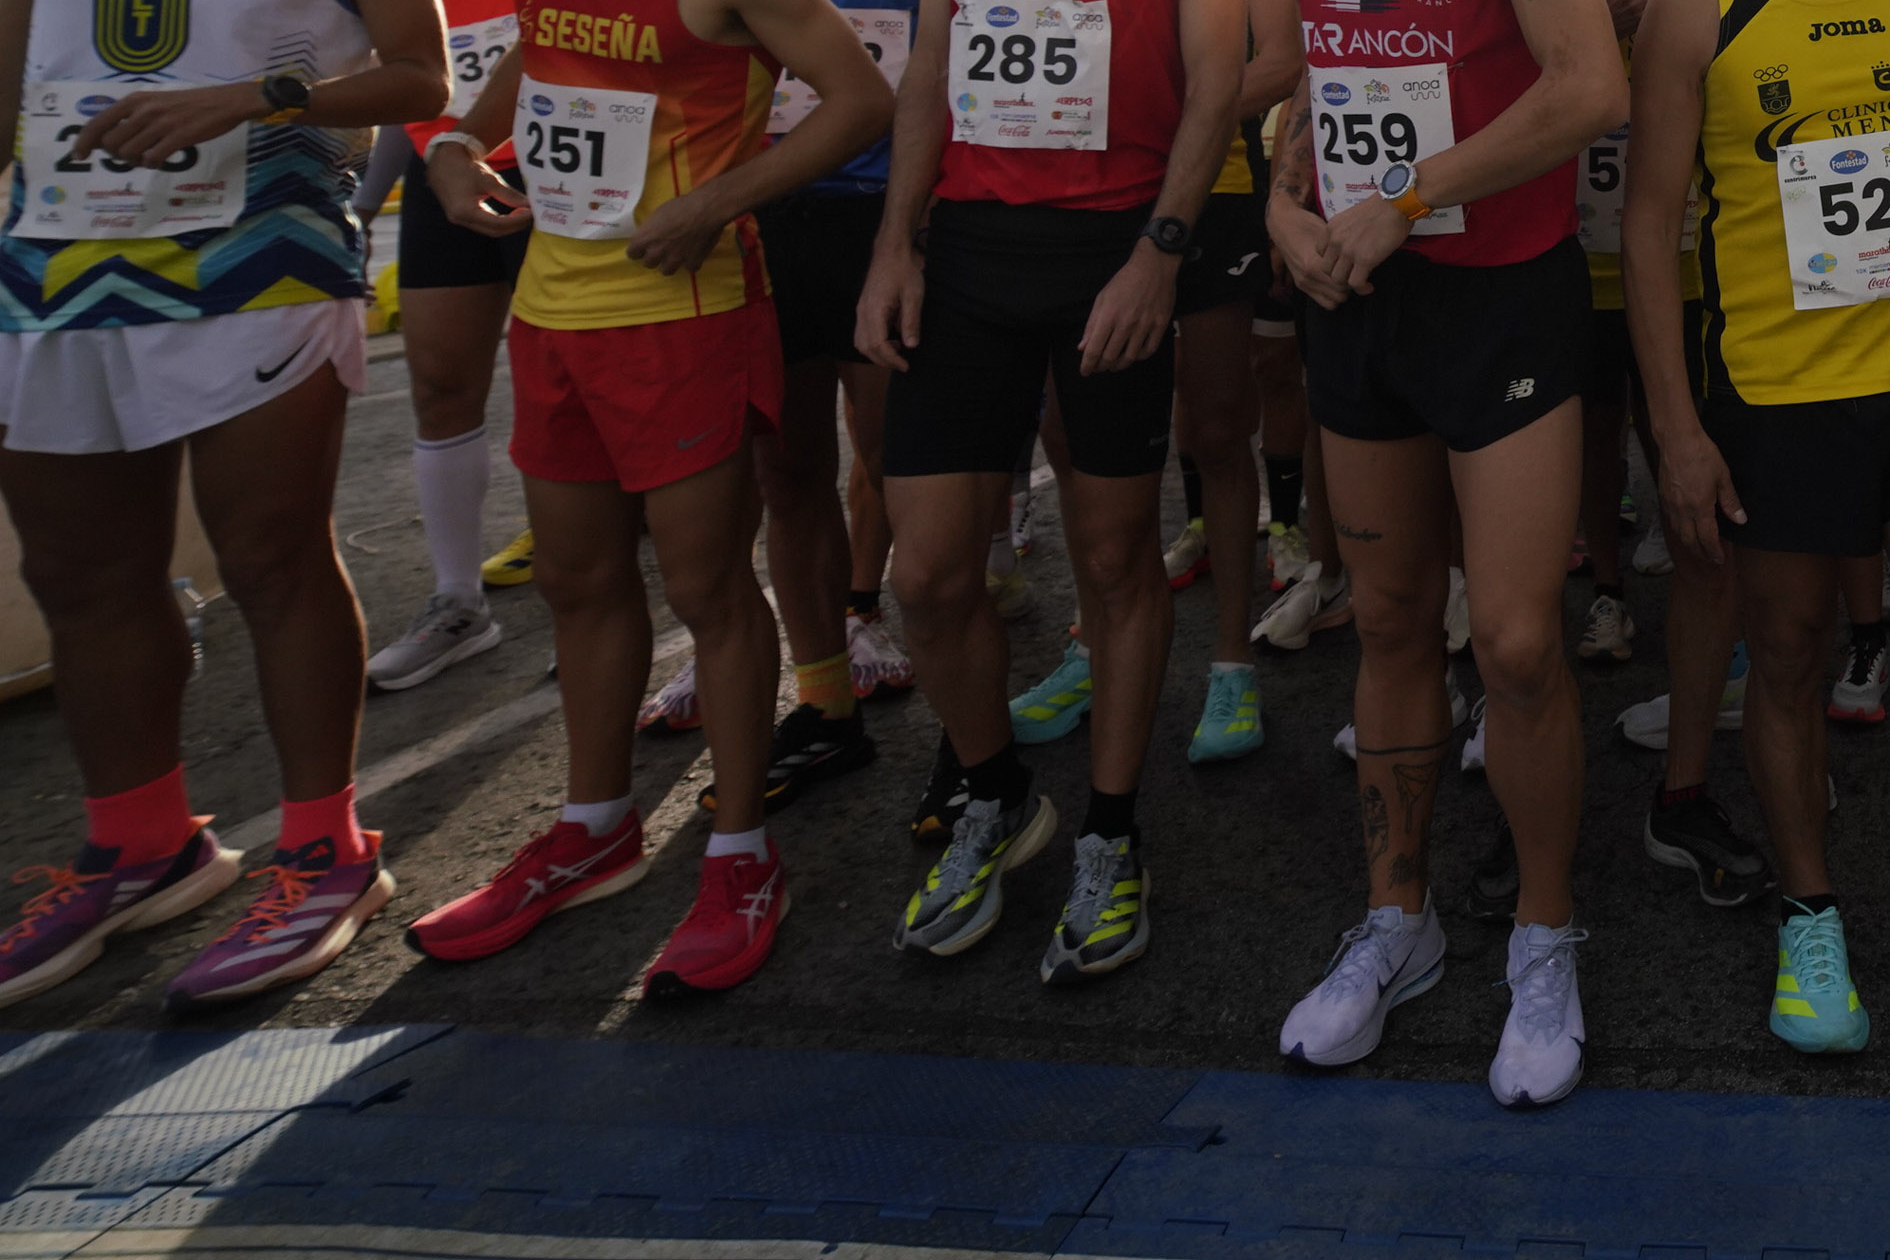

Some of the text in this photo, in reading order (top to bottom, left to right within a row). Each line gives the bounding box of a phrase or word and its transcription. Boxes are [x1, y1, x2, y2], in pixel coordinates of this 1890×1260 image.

[535, 7, 663, 64] SESEÑA
[1301, 20, 1454, 58] TARANCÓN
[967, 34, 1078, 85] 285
[1402, 79, 1440, 92] anoa
[609, 104, 646, 115] anoa
[526, 121, 606, 178] 251
[1319, 112, 1418, 165] 259
[1831, 155, 1868, 170] Fontestad
